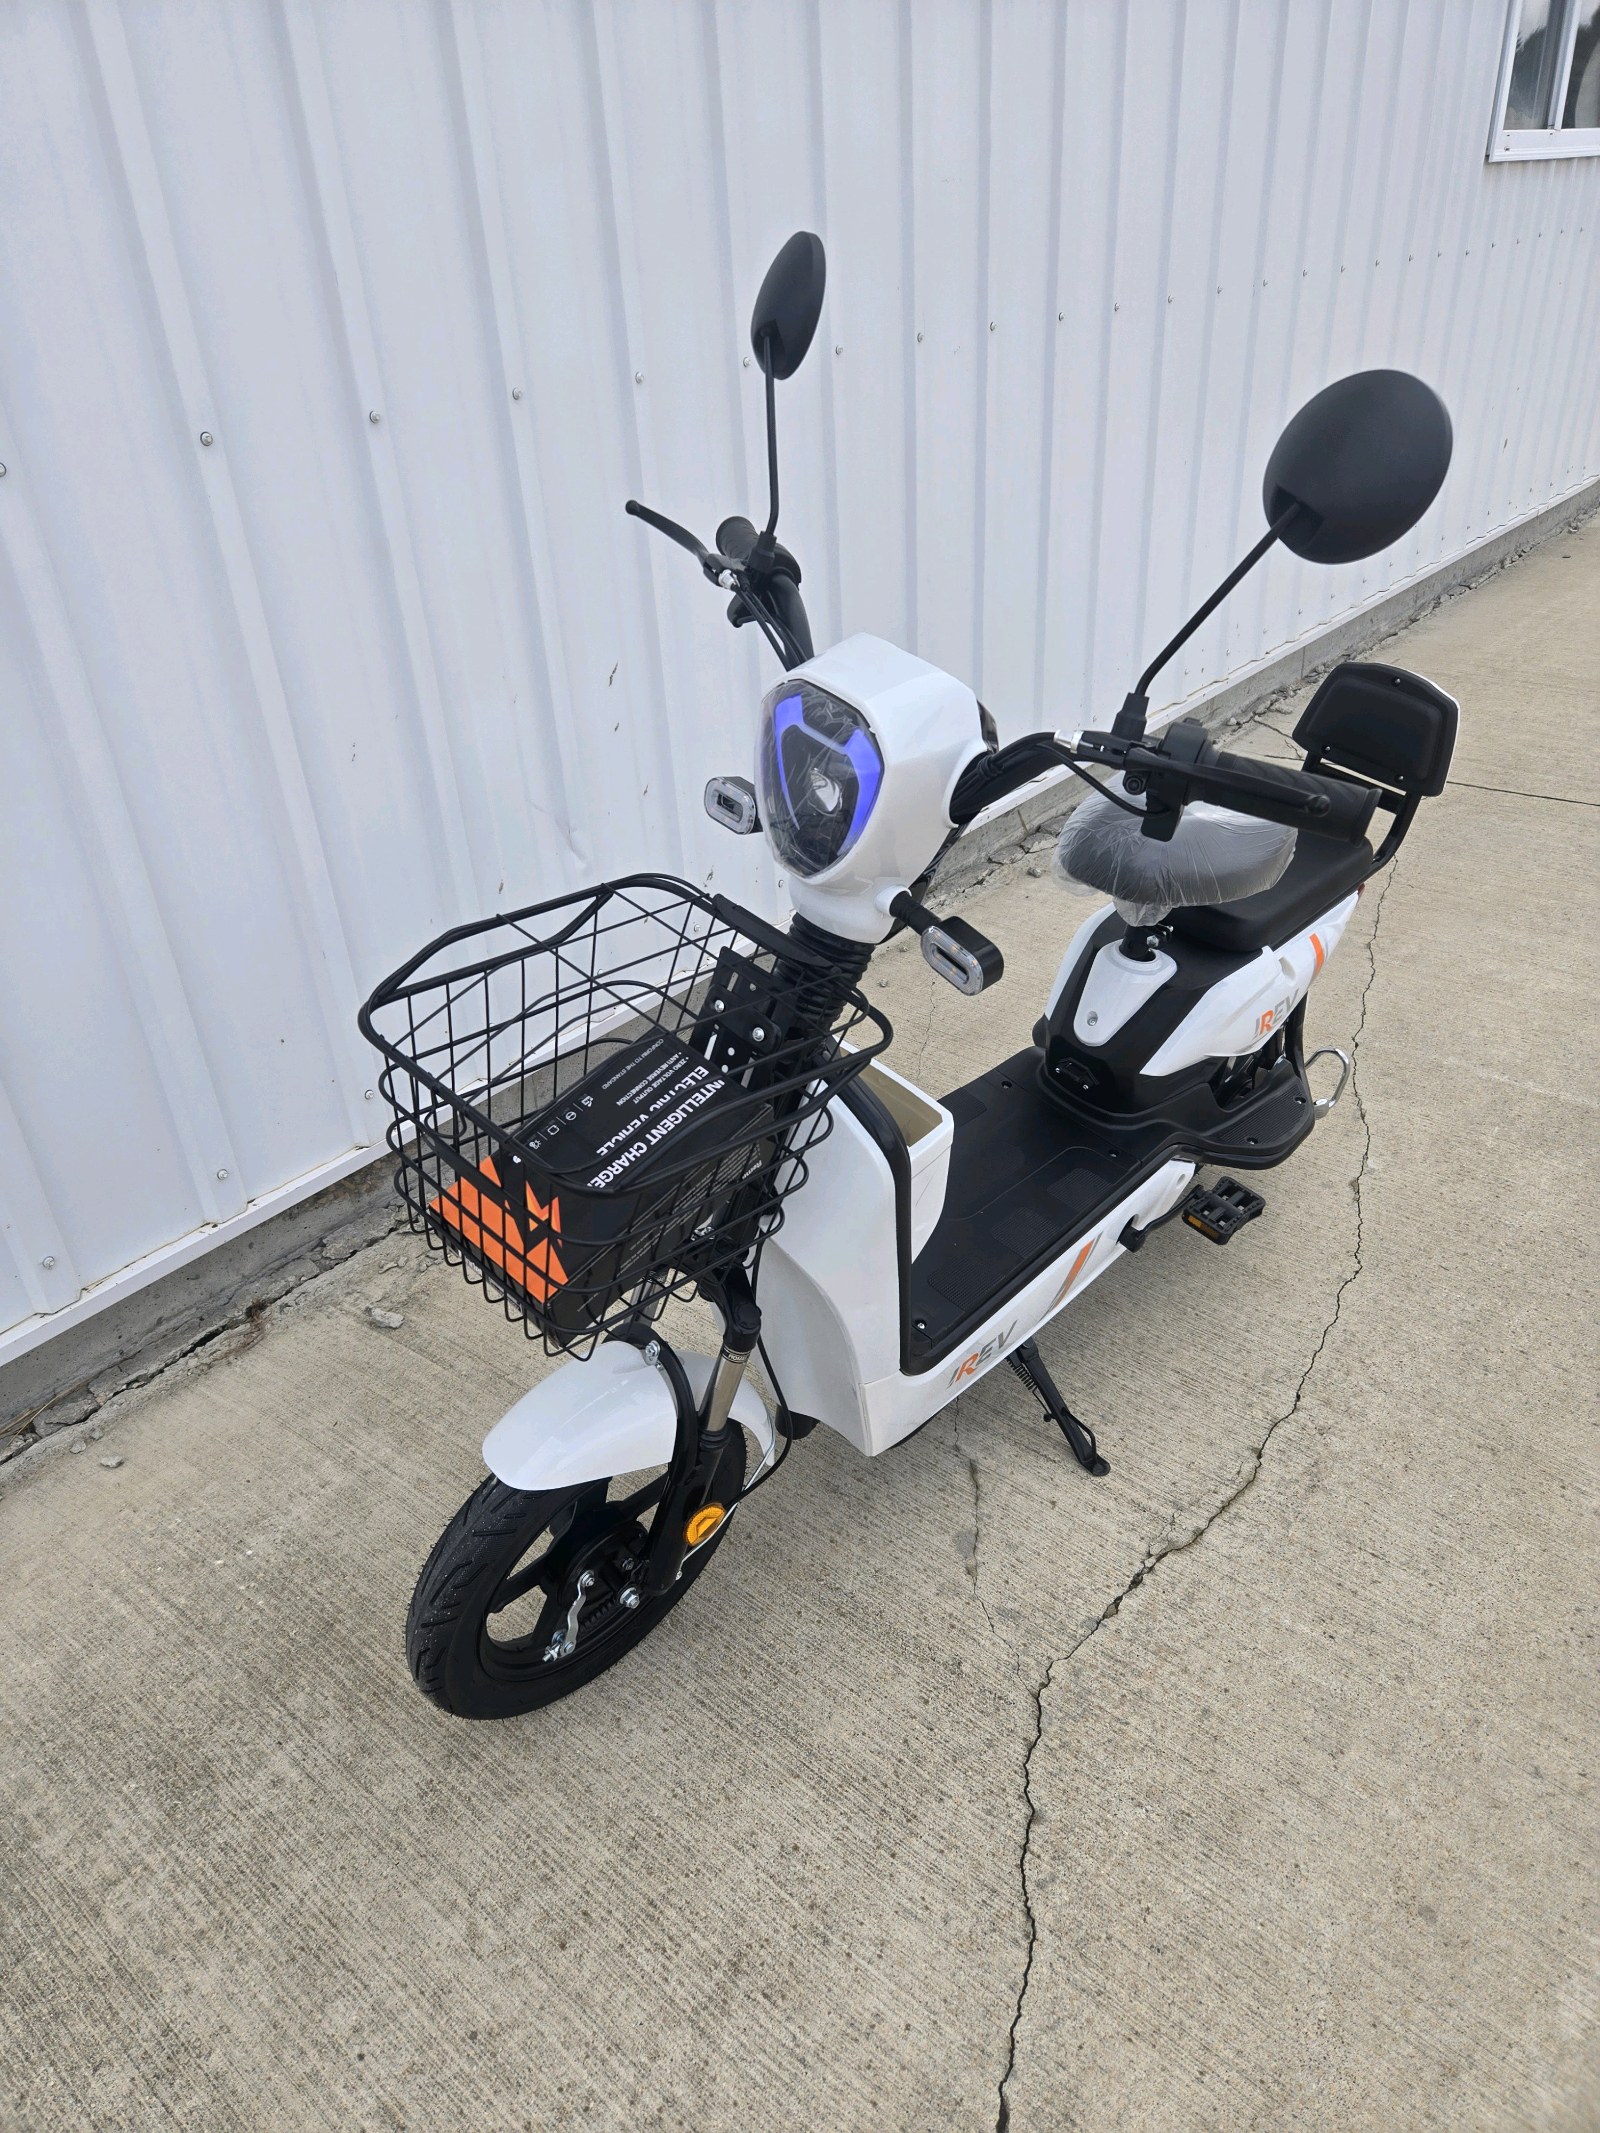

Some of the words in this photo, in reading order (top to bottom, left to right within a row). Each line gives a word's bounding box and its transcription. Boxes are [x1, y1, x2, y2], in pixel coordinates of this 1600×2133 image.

[640, 1038, 664, 1058] CONFORM
[665, 1053, 680, 1067] ANTI
[672, 1058, 688, 1073] ZERO
[601, 1068, 627, 1090] STANDARD
[645, 1062, 669, 1082] REVERSE
[651, 1069, 675, 1089] VOLTAGE
[615, 1079, 649, 1107] CONNECTION
[632, 1086, 654, 1105] OUTPUT
[645, 1079, 726, 1146] INTELLIGENT
[586, 1142, 648, 1188] CHARGE
[946, 1319, 1018, 1390] IREV
